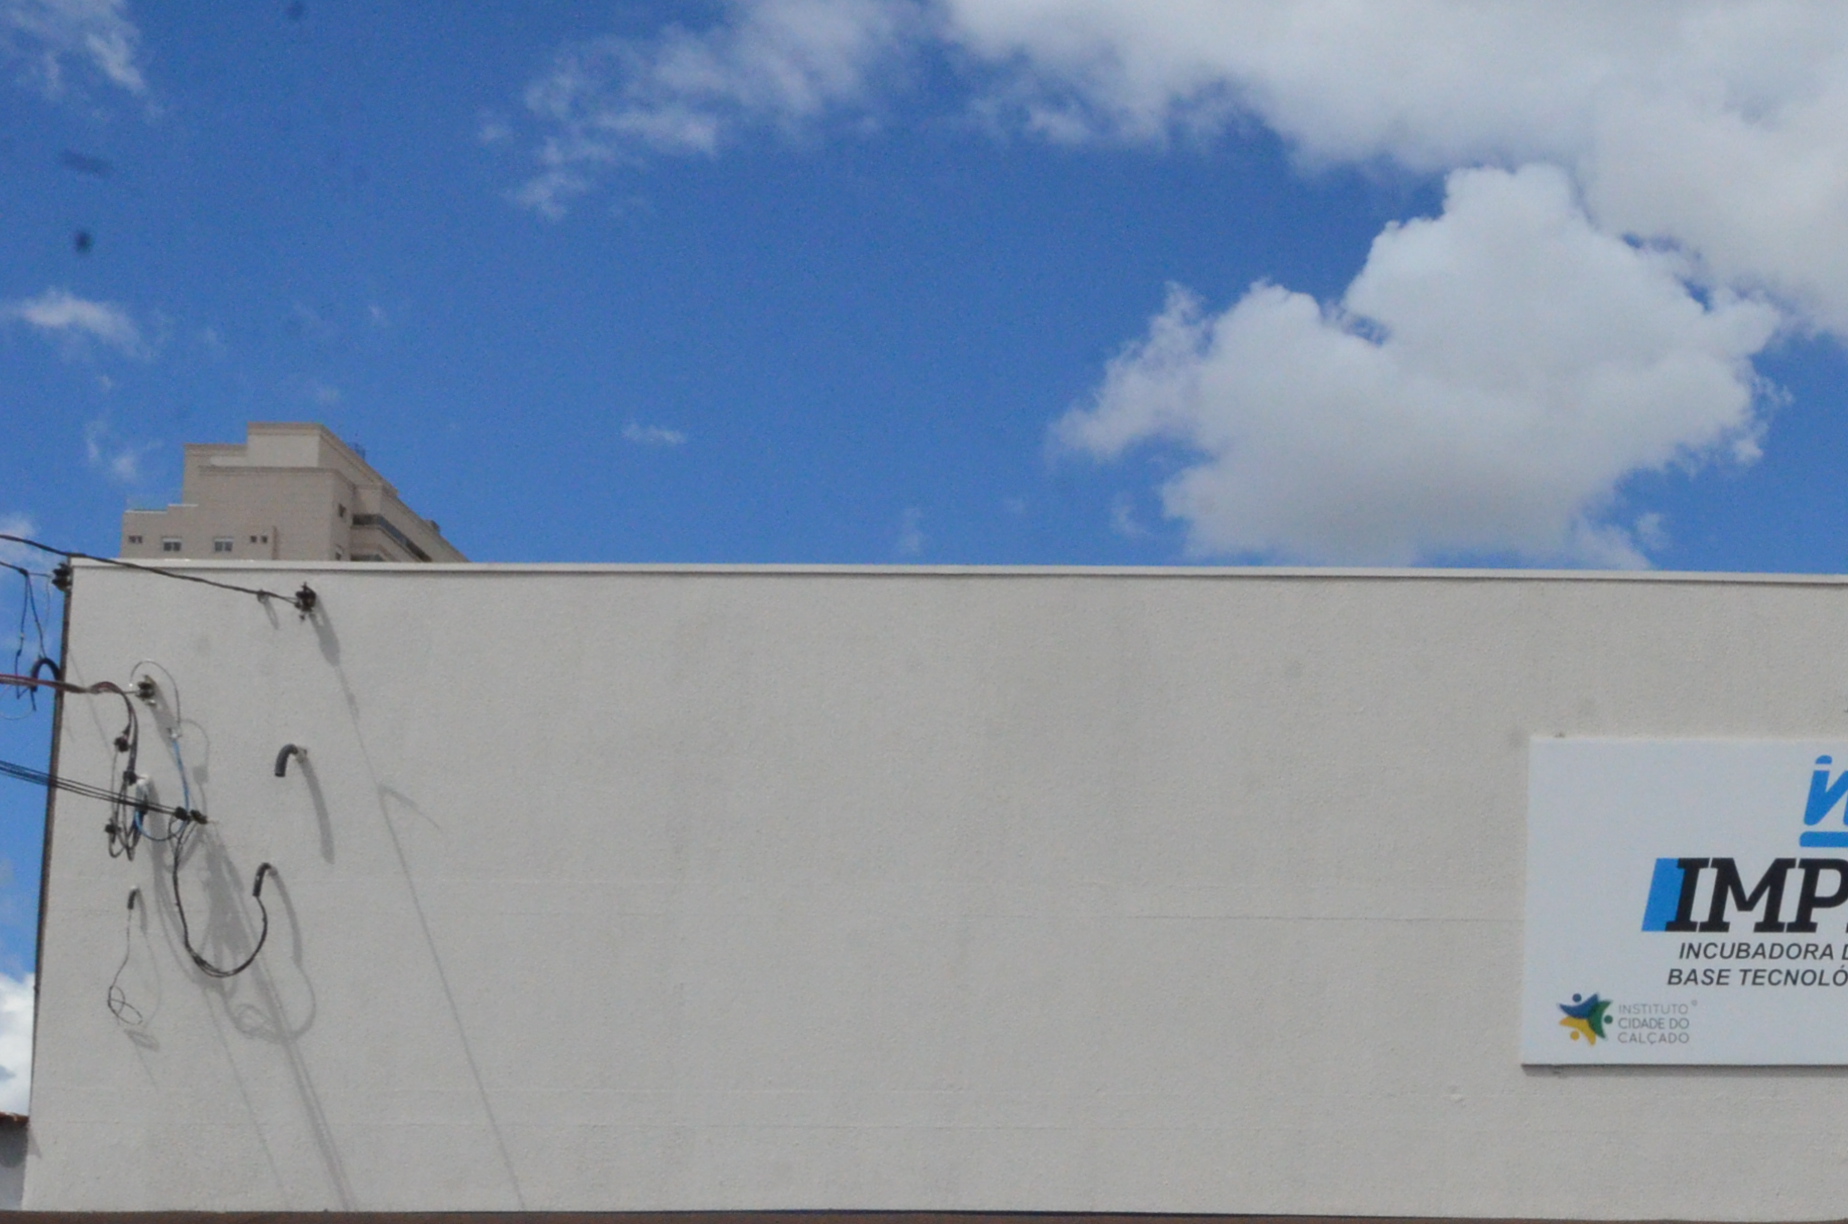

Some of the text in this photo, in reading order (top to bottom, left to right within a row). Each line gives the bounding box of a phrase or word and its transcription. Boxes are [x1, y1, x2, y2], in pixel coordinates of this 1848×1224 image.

[1679, 942, 1834, 961] INCUBADORA
[1667, 968, 1731, 985] BASE
[1618, 1003, 1689, 1015] INSTITUTO
[1617, 1017, 1690, 1030] CIDADE DO
[1617, 1032, 1690, 1045] CALÇADO
